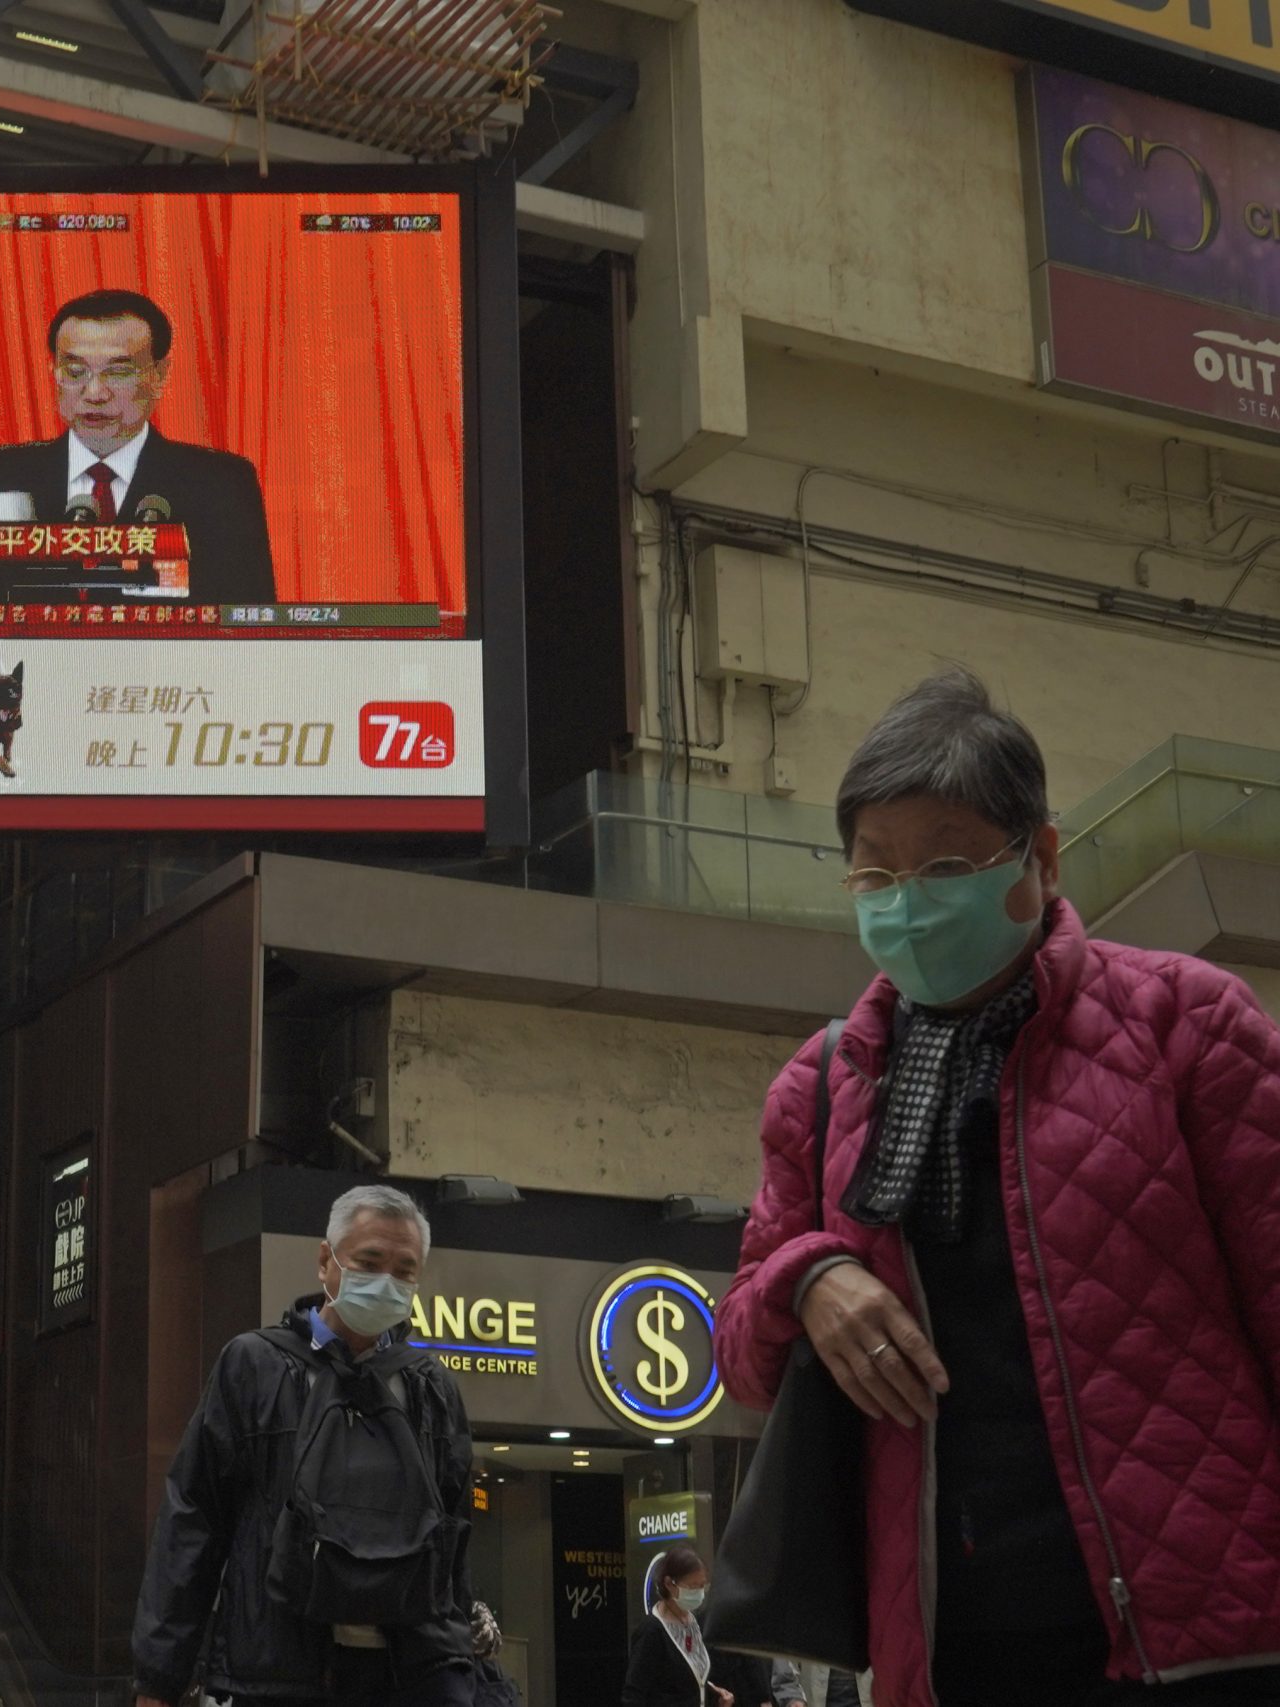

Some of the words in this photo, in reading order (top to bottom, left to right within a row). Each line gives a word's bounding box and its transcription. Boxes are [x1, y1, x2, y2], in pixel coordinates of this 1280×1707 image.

[85, 685, 215, 715] 逢星期六
[85, 739, 148, 769] 晚上
[164, 721, 336, 768] 10:30
[476, 1356, 538, 1376] CENTRE
[638, 1511, 688, 1536] CHANGE
[587, 1565, 626, 1578] UNIO
